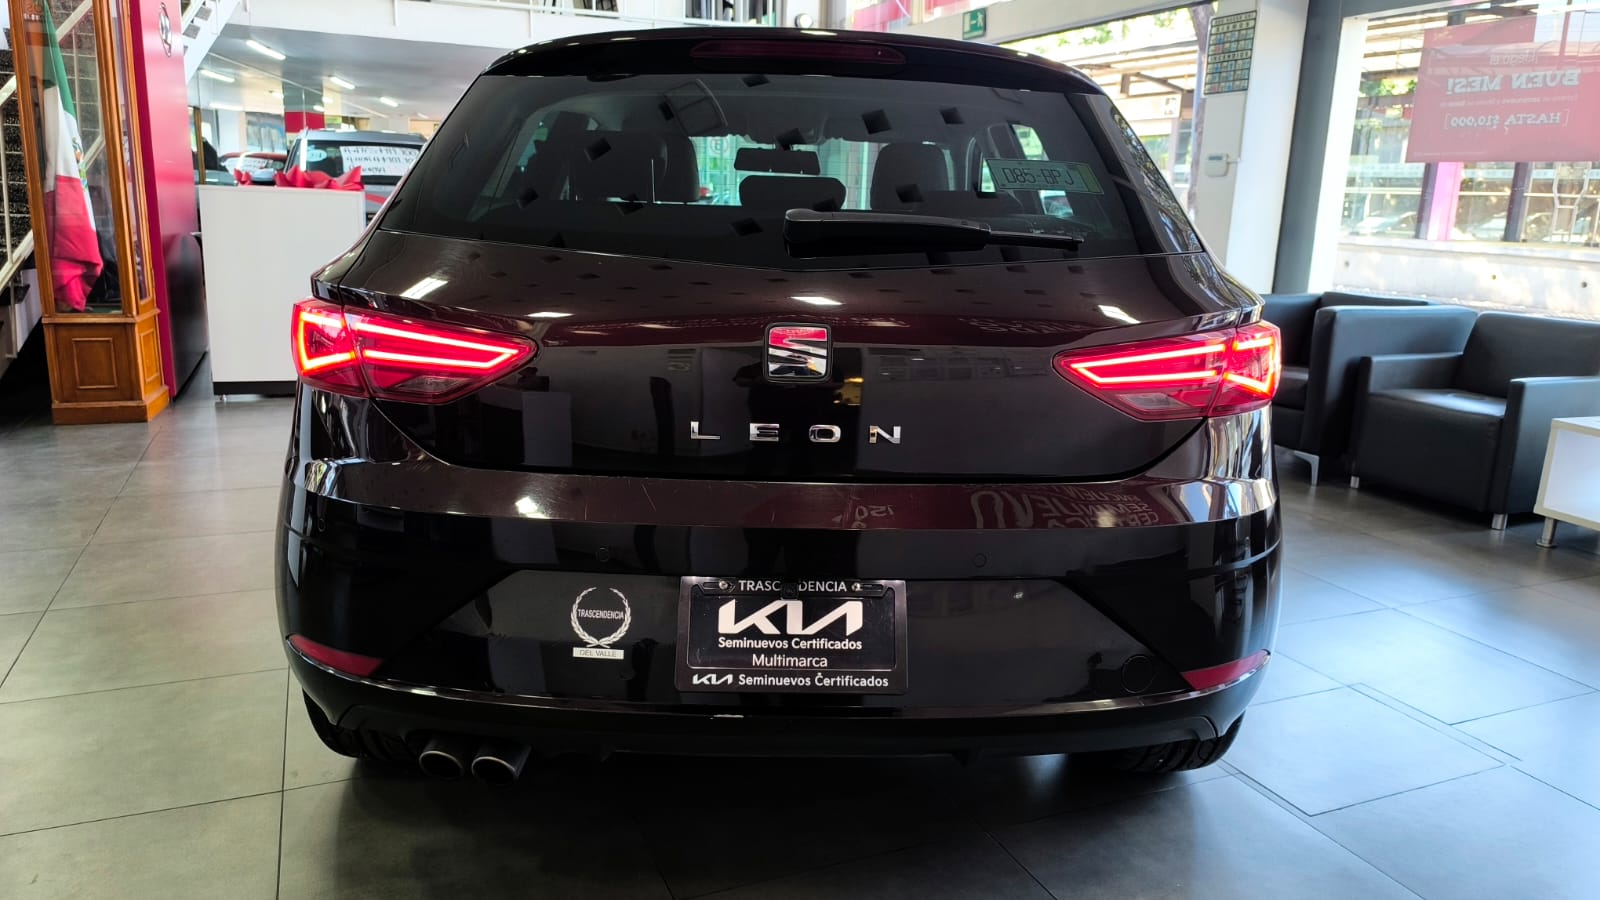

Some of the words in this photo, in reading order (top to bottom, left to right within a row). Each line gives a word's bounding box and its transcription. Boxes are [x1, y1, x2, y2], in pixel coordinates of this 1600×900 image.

[689, 420, 902, 444] LEON
[738, 580, 848, 592] TRASCDENCIA
[577, 608, 625, 619] TRASCENDENCIA
[718, 598, 864, 636] KIA
[718, 636, 789, 650] Seminuevos
[791, 637, 863, 650] Certificados
[579, 649, 593, 657] DEL
[595, 649, 618, 658] VALLE
[752, 653, 828, 667] Multimarca
[692, 673, 734, 685] KIA
[738, 673, 811, 687] Seminuevos
[814, 674, 889, 688] Certificados
